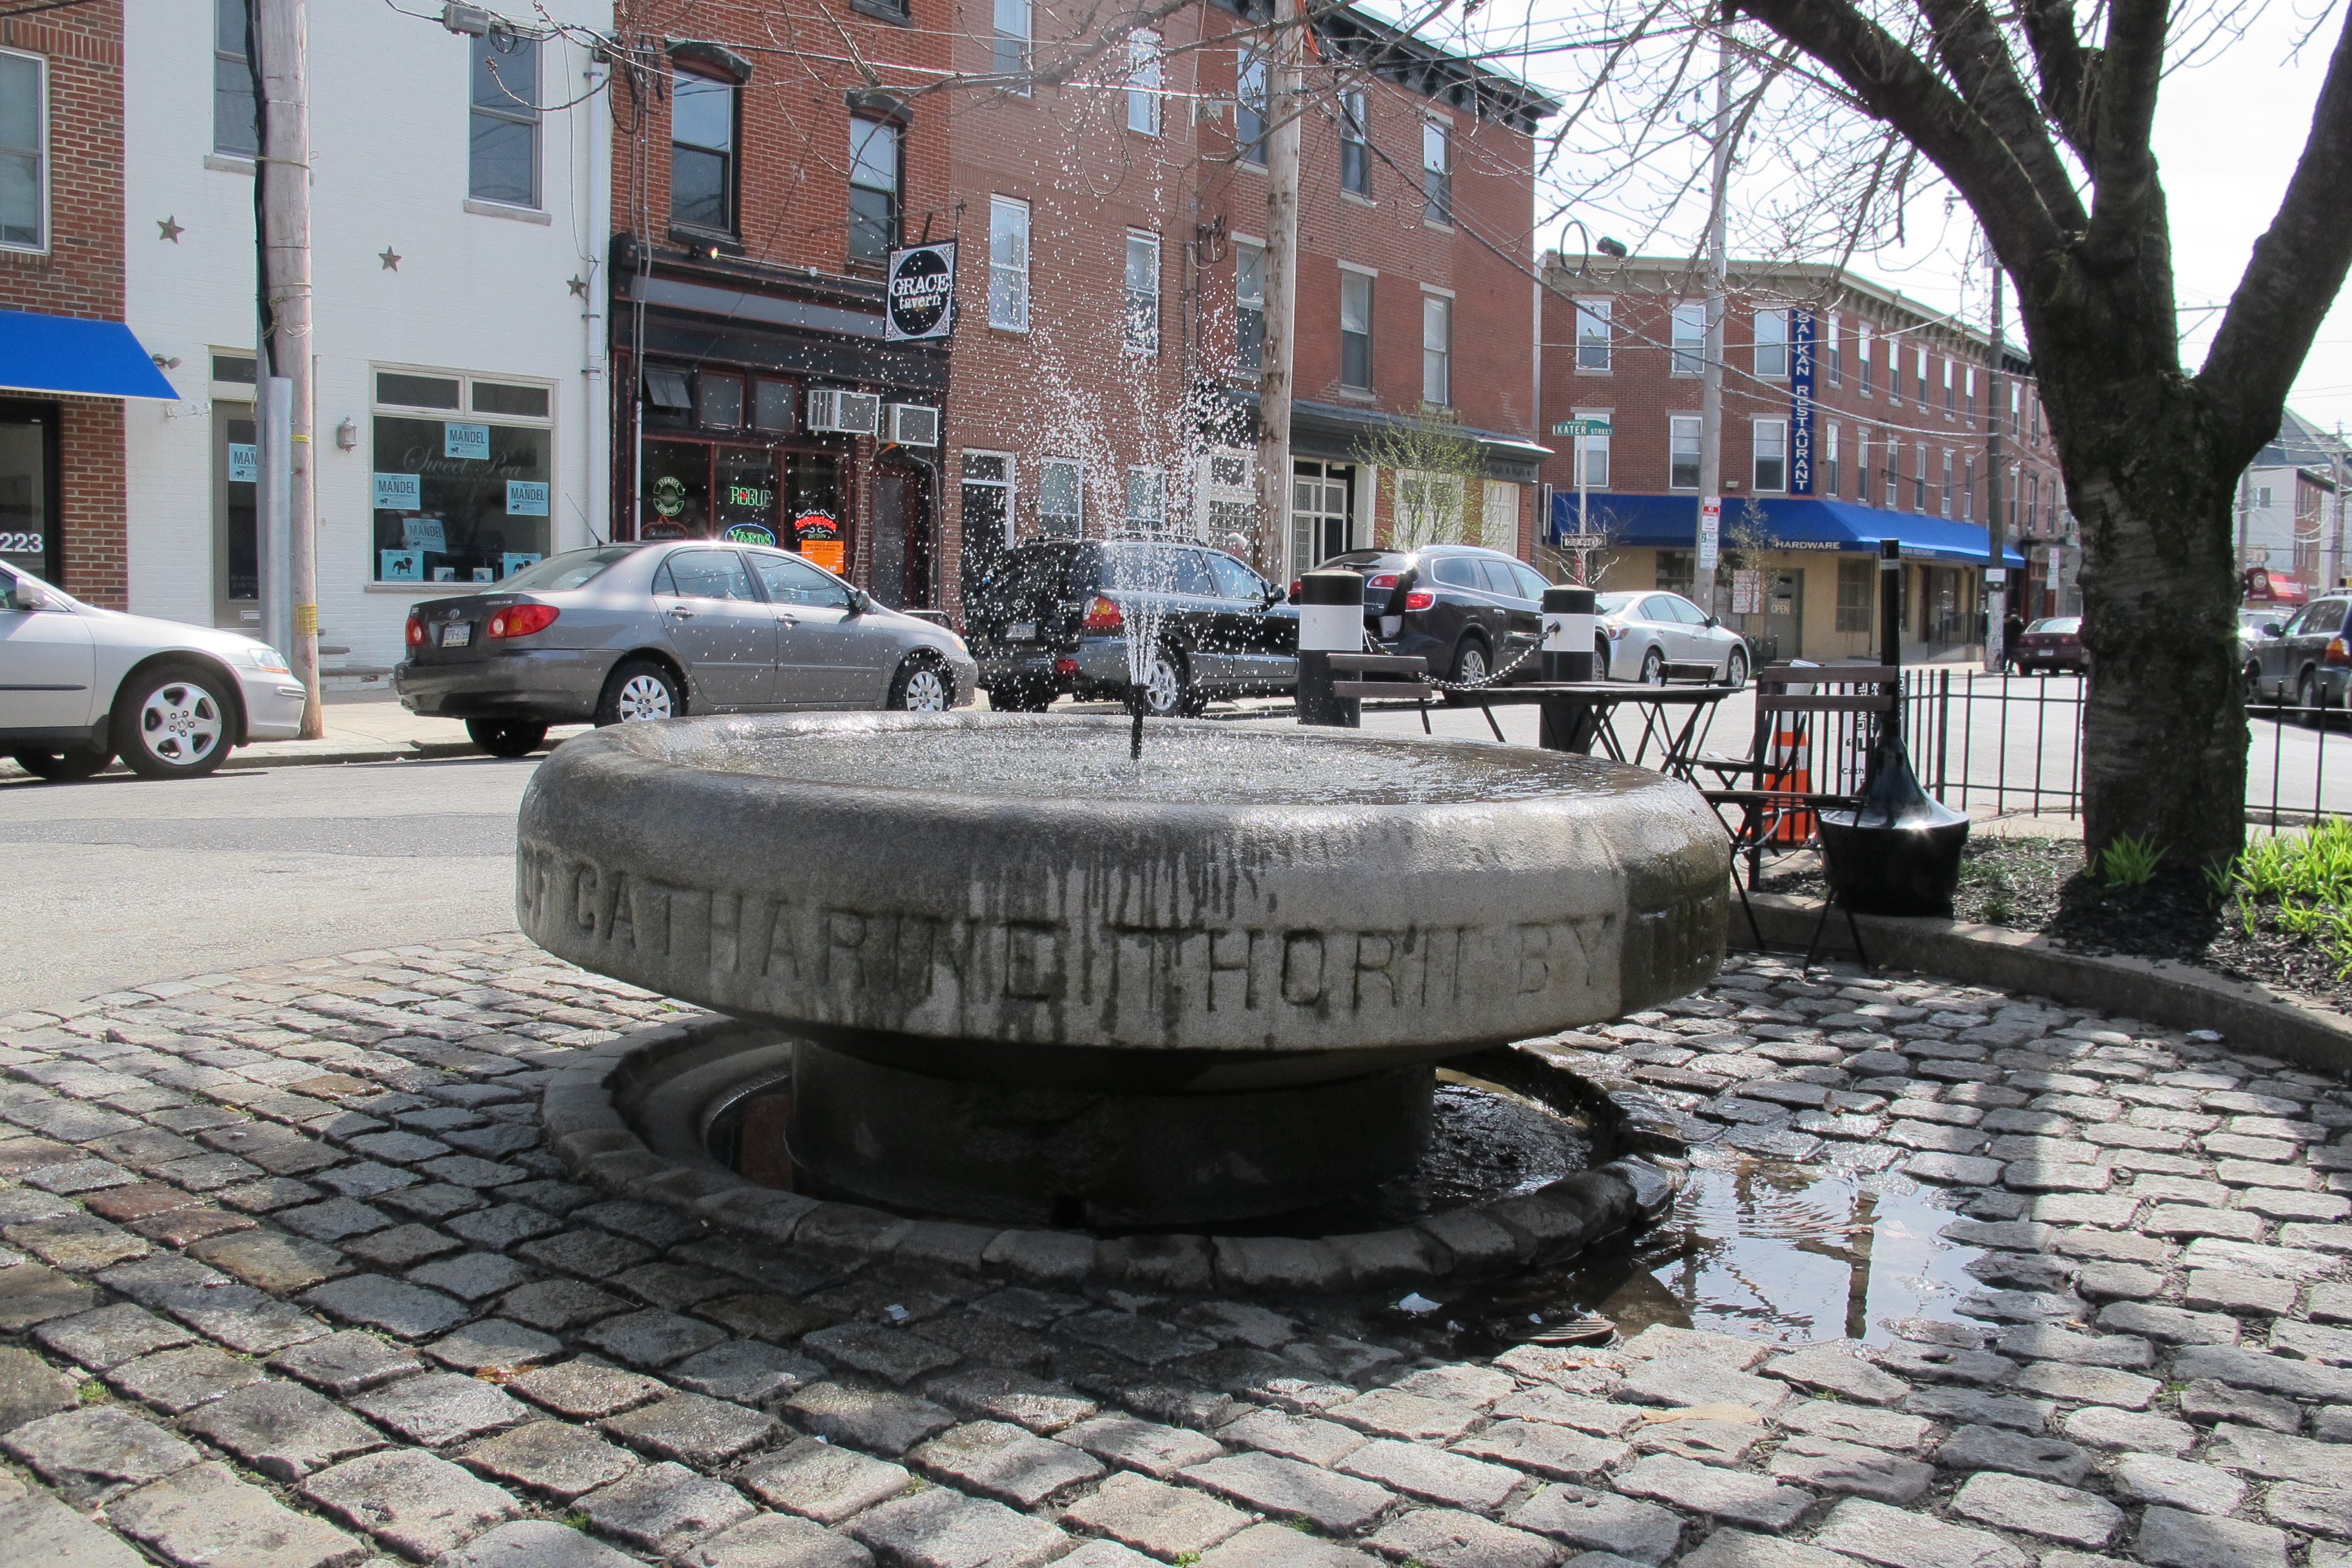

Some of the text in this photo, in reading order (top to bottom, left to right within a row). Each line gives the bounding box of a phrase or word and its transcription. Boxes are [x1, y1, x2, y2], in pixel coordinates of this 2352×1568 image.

[892, 273, 948, 297] GRACE
[899, 294, 941, 309] tavern
[1796, 313, 1810, 490] BALKAN RESTAURANT
[450, 429, 485, 444] MANDEL
[1558, 426, 1586, 435] KATER
[235, 451, 257, 465] MAN
[378, 480, 415, 494] MANDEL
[511, 487, 545, 501] MANDEL
[729, 487, 770, 507] ROGUE
[409, 525, 442, 538] MANDEL
[730, 529, 772, 546] YARDS
[0, 533, 43, 553] 223
[576, 862, 1061, 1001] CATHARINE
[1517, 913, 1617, 995] BY
